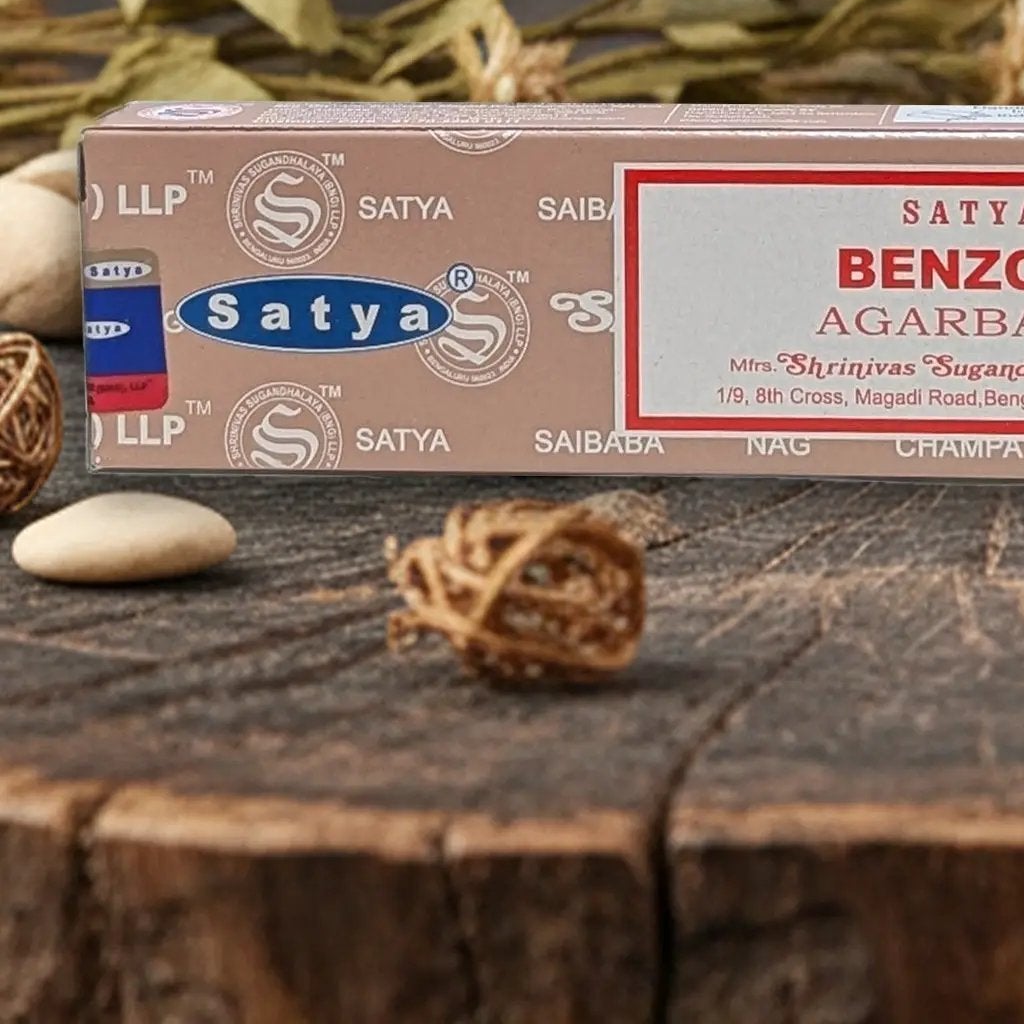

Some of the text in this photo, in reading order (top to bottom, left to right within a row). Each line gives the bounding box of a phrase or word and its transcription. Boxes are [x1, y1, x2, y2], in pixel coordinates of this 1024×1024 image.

[358, 195, 615, 221] SATYA SAIB
[87, 324, 122, 336] atya
[207, 292, 429, 341] Satya
[730, 358, 777, 373] Mfrs.
[777, 352, 916, 380] Shrinivas
[717, 387, 749, 406] 1/9,
[756, 387, 783, 405] 8th
[790, 388, 848, 407] Cross,
[855, 388, 922, 409] Magadi
[356, 427, 450, 452] SATYA
[534, 429, 665, 455] SAIBABA
[747, 436, 811, 457] NAG
[896, 439, 1024, 459] CHAMPA
